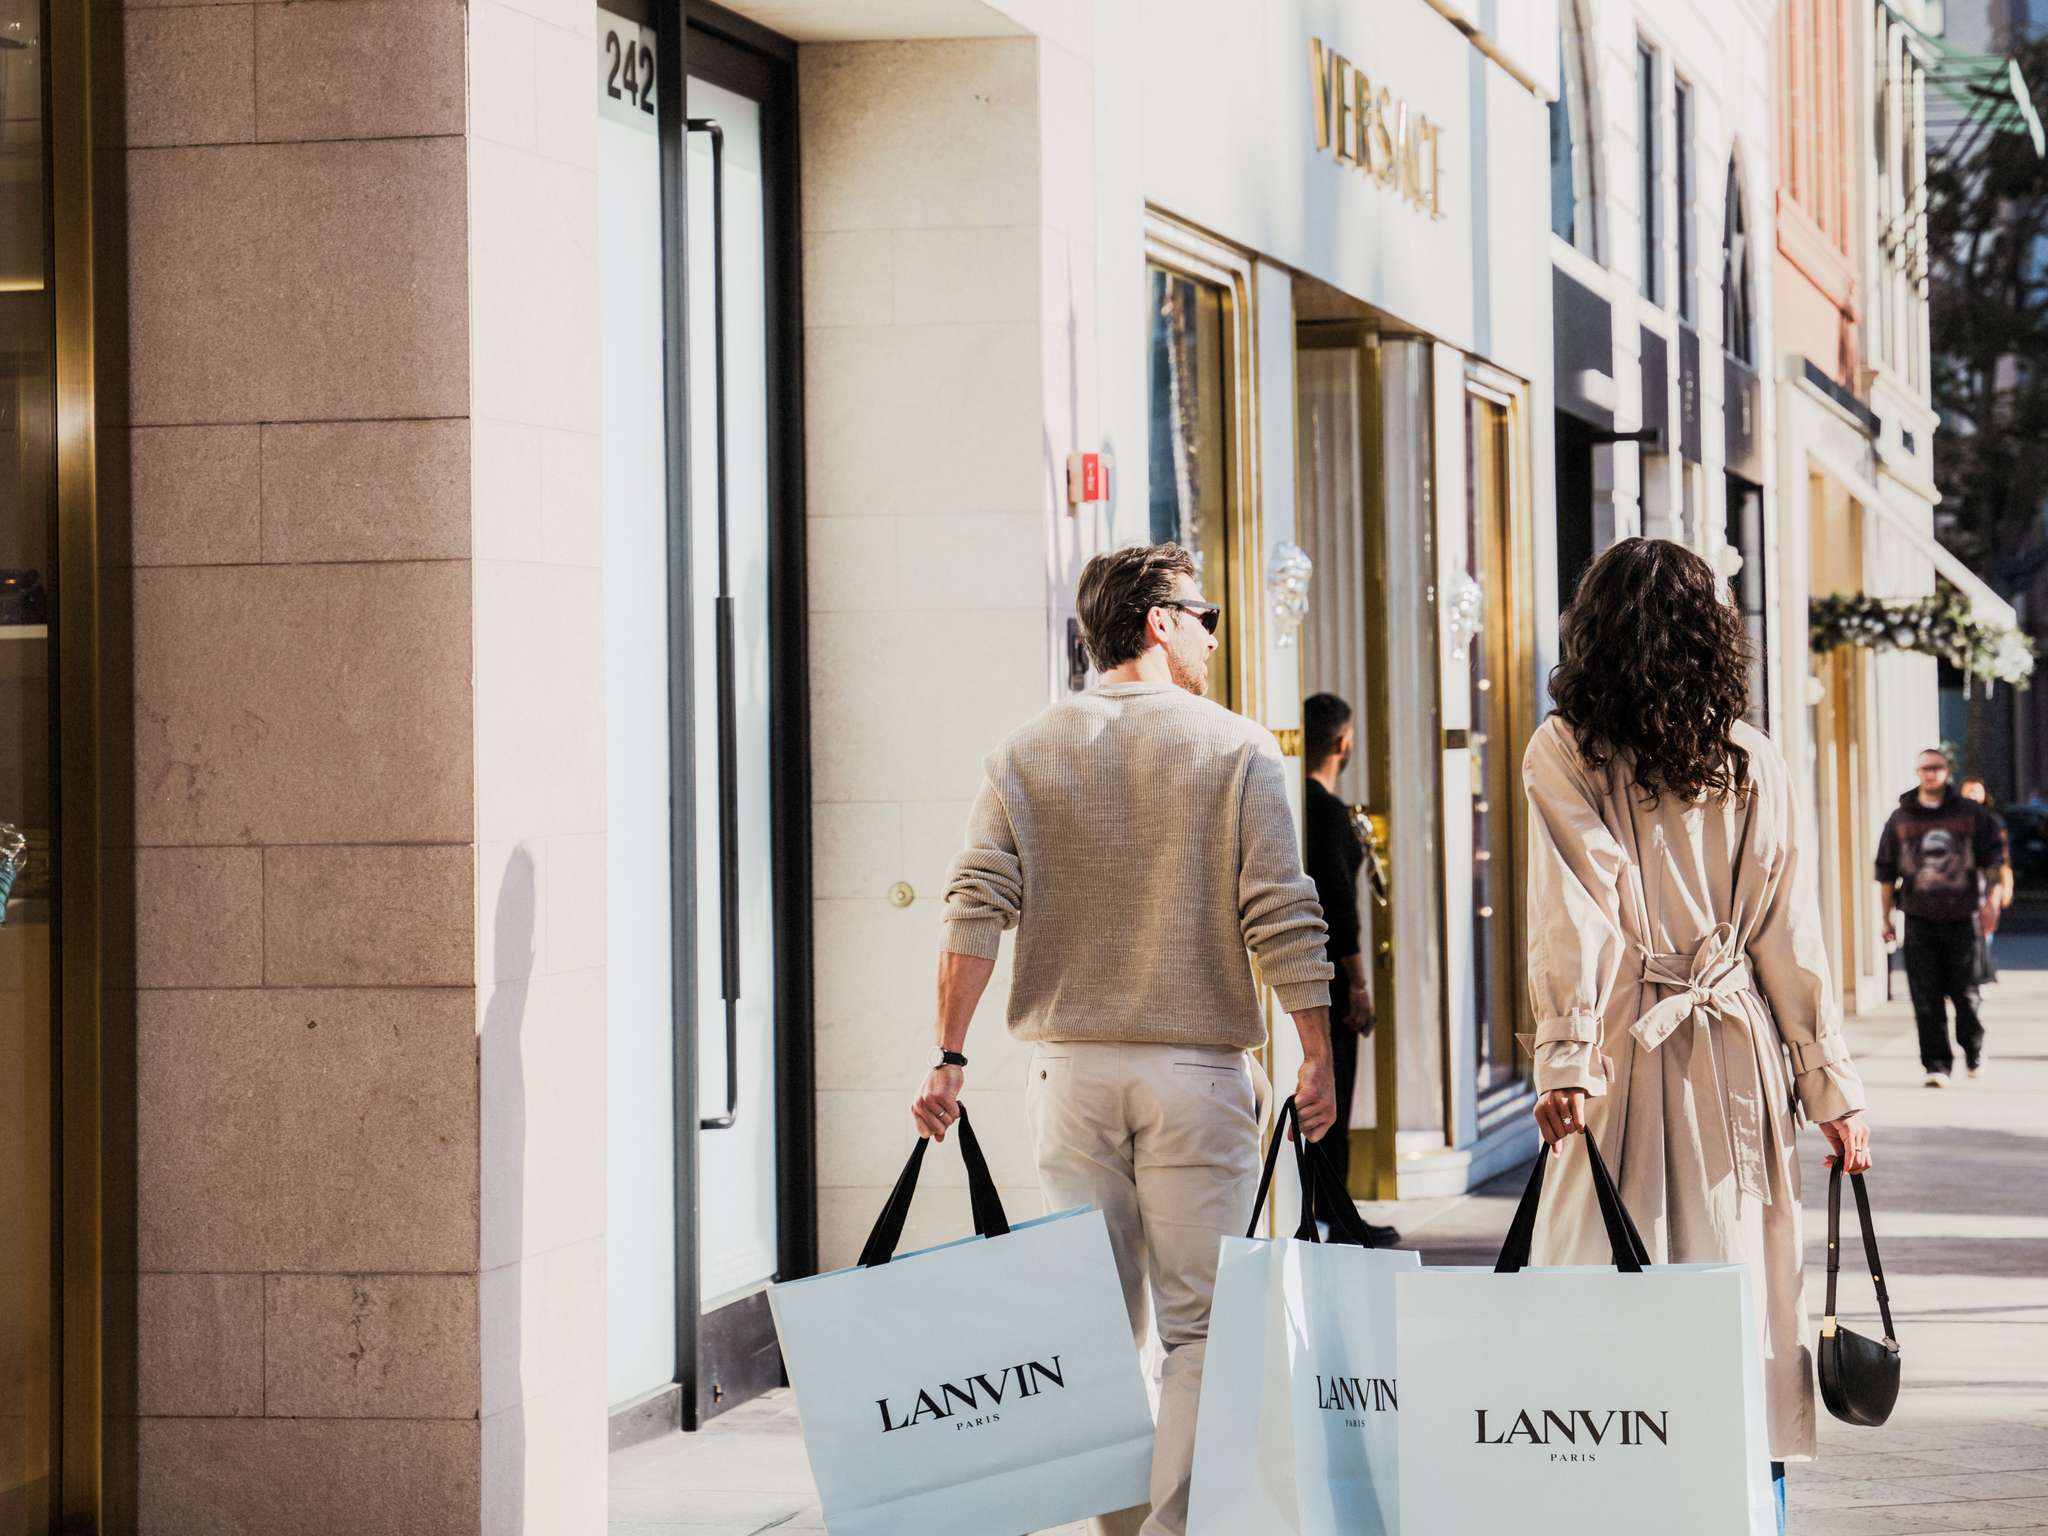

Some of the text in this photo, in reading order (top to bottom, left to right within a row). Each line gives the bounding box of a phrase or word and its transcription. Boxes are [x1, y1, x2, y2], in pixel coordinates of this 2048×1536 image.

[606, 29, 655, 116] 242
[1311, 36, 1442, 219] VERSACE
[875, 1355, 1065, 1433] LANVIN
[1316, 1375, 1398, 1412] LANVIN
[956, 1413, 1001, 1431] PARIS
[1345, 1419, 1366, 1428] PARIS
[1474, 1408, 1669, 1446] LANVIN
[1550, 1453, 1596, 1463] PARIS
